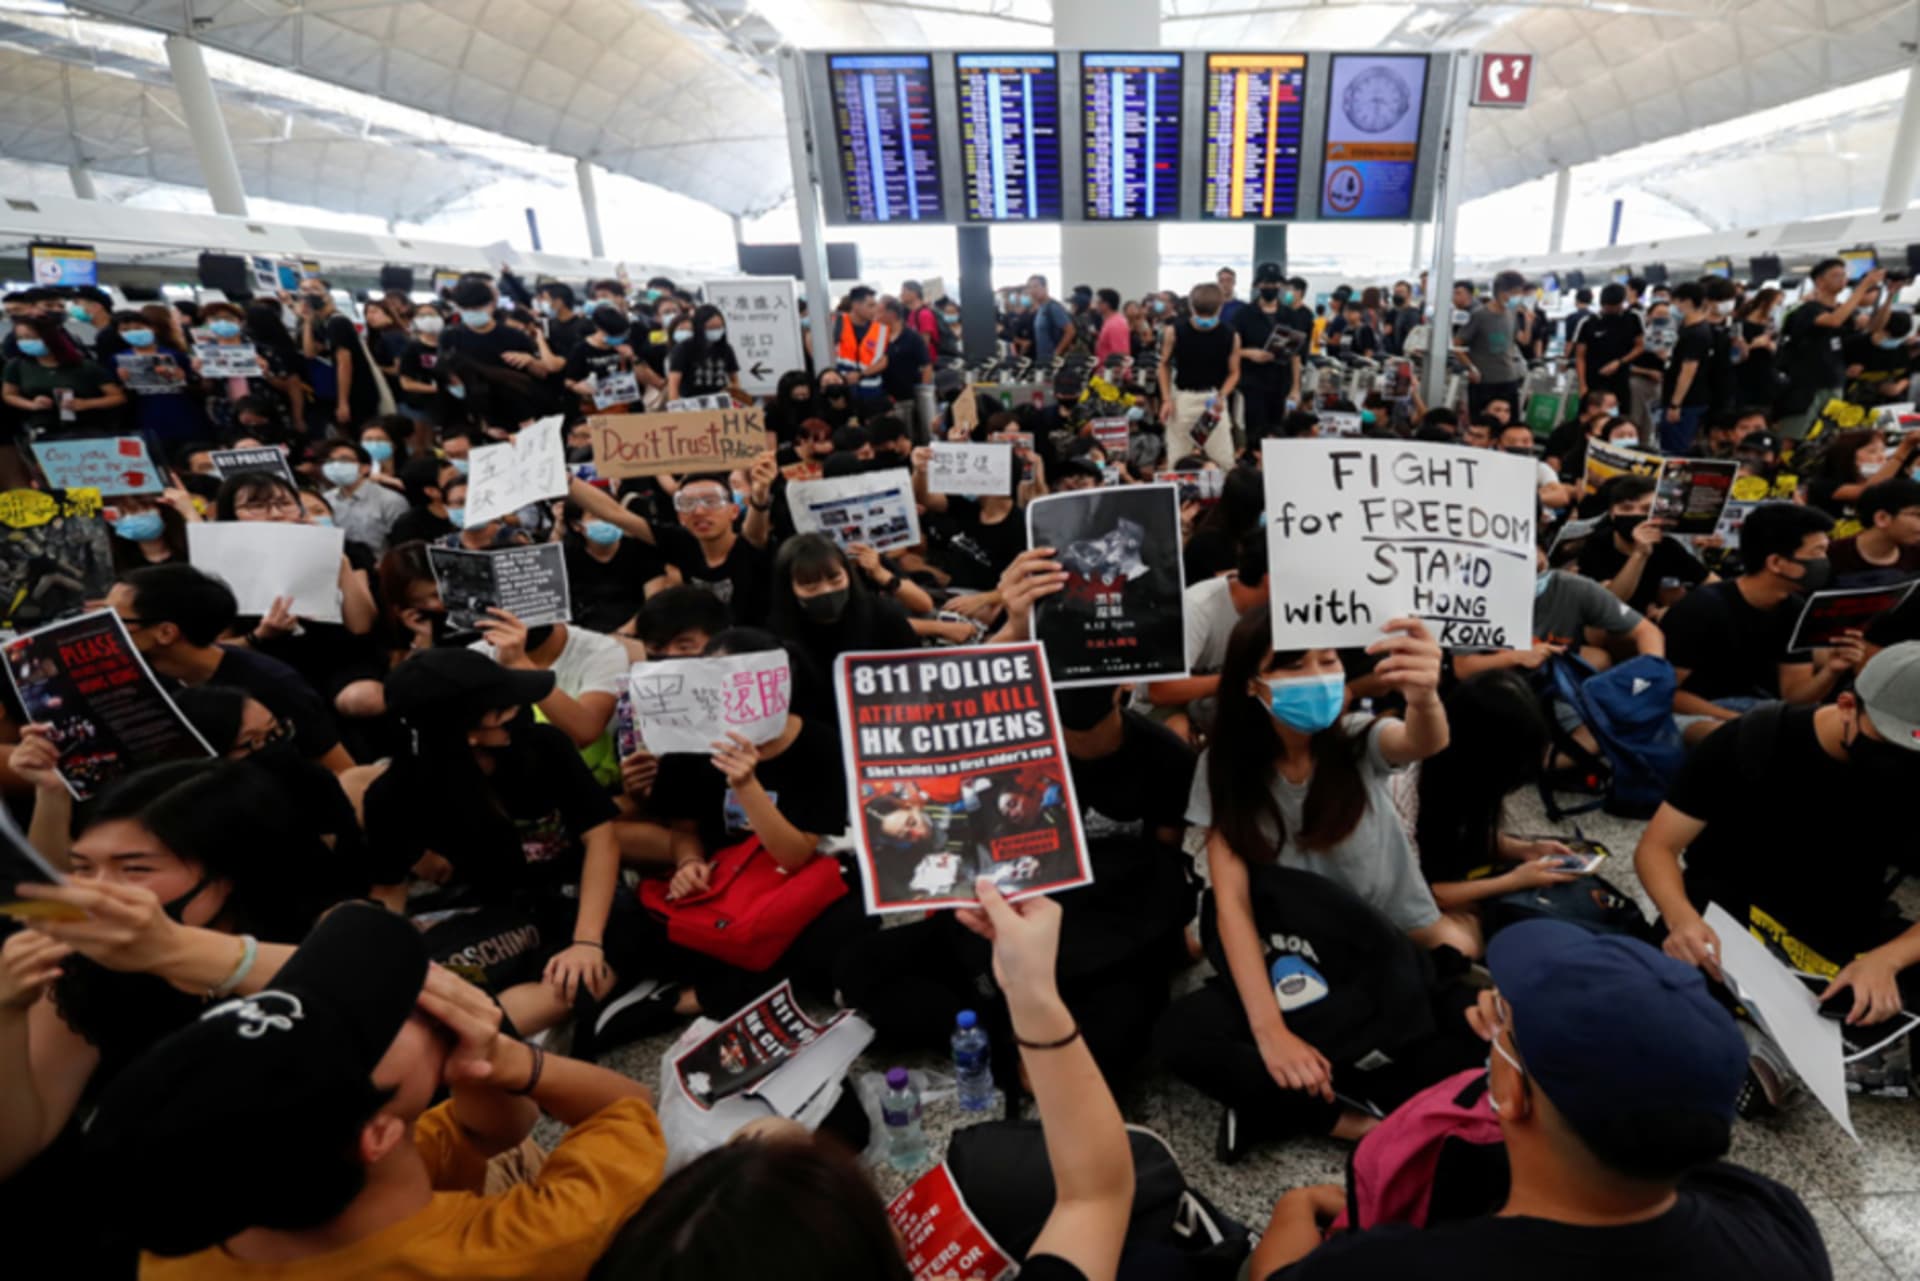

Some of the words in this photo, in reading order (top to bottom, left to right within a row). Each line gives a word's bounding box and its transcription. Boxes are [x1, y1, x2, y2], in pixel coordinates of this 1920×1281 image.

[741, 334, 773, 347] 出口
[747, 348, 769, 358] Exit
[603, 428, 661, 461] Don't
[661, 423, 720, 456] Trust
[723, 413, 763, 435] HK
[1329, 451, 1478, 491] FIGHT
[1276, 501, 1343, 538] for
[1359, 497, 1530, 544] FREEDOM
[1366, 543, 1492, 588] STAND
[1284, 589, 1372, 625] with
[1413, 586, 1487, 618] HONG
[59, 632, 121, 668] PLEASE
[1440, 621, 1507, 647] KONG
[854, 665, 911, 695] 811
[919, 656, 1032, 692] POLICE
[859, 703, 946, 724] ATTEMPT
[952, 699, 977, 718] TO
[982, 685, 1039, 712] KILL
[861, 727, 904, 755] HK
[912, 711, 1045, 753] CITIZENS
[866, 764, 893, 778] Shot
[899, 763, 933, 777] bullet
[935, 762, 947, 775] to
[949, 763, 958, 773] a
[960, 755, 985, 771] first
[1030, 746, 1053, 761] eye
[446, 924, 540, 968] OSCHINO
[745, 1010, 765, 1036] HK
[959, 1246, 984, 1270] OR
